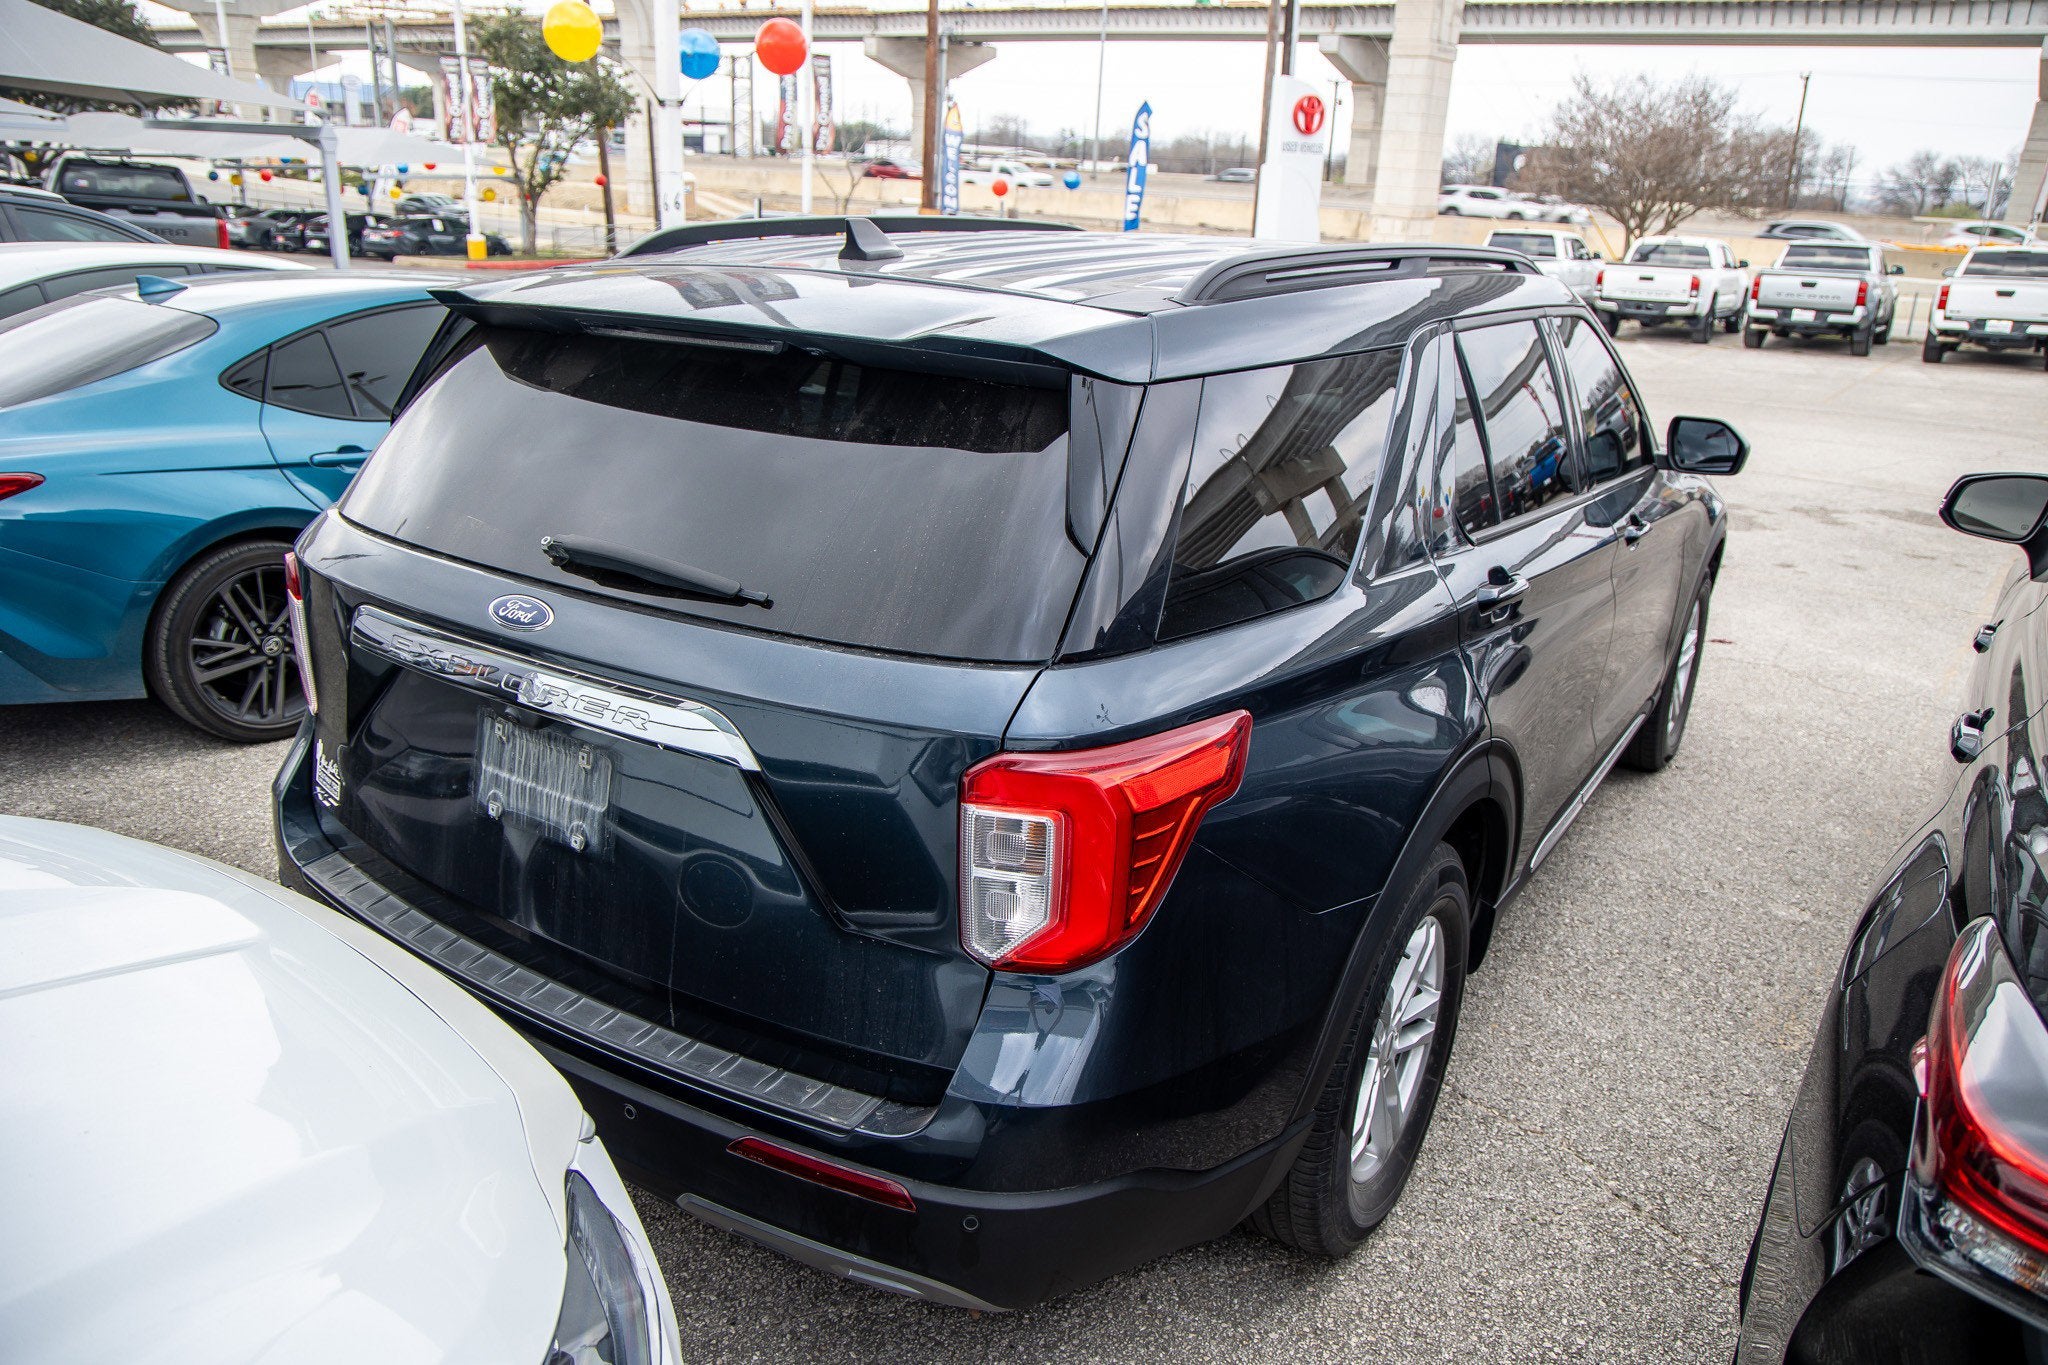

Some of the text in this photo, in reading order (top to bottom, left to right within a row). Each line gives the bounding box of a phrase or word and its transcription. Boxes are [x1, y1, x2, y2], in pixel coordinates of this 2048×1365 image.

[1126, 111, 1149, 221] SALE
[1775, 291, 1841, 300] TACOMA
[499, 599, 539, 624] Ford
[389, 633, 652, 732] EXPLORER
